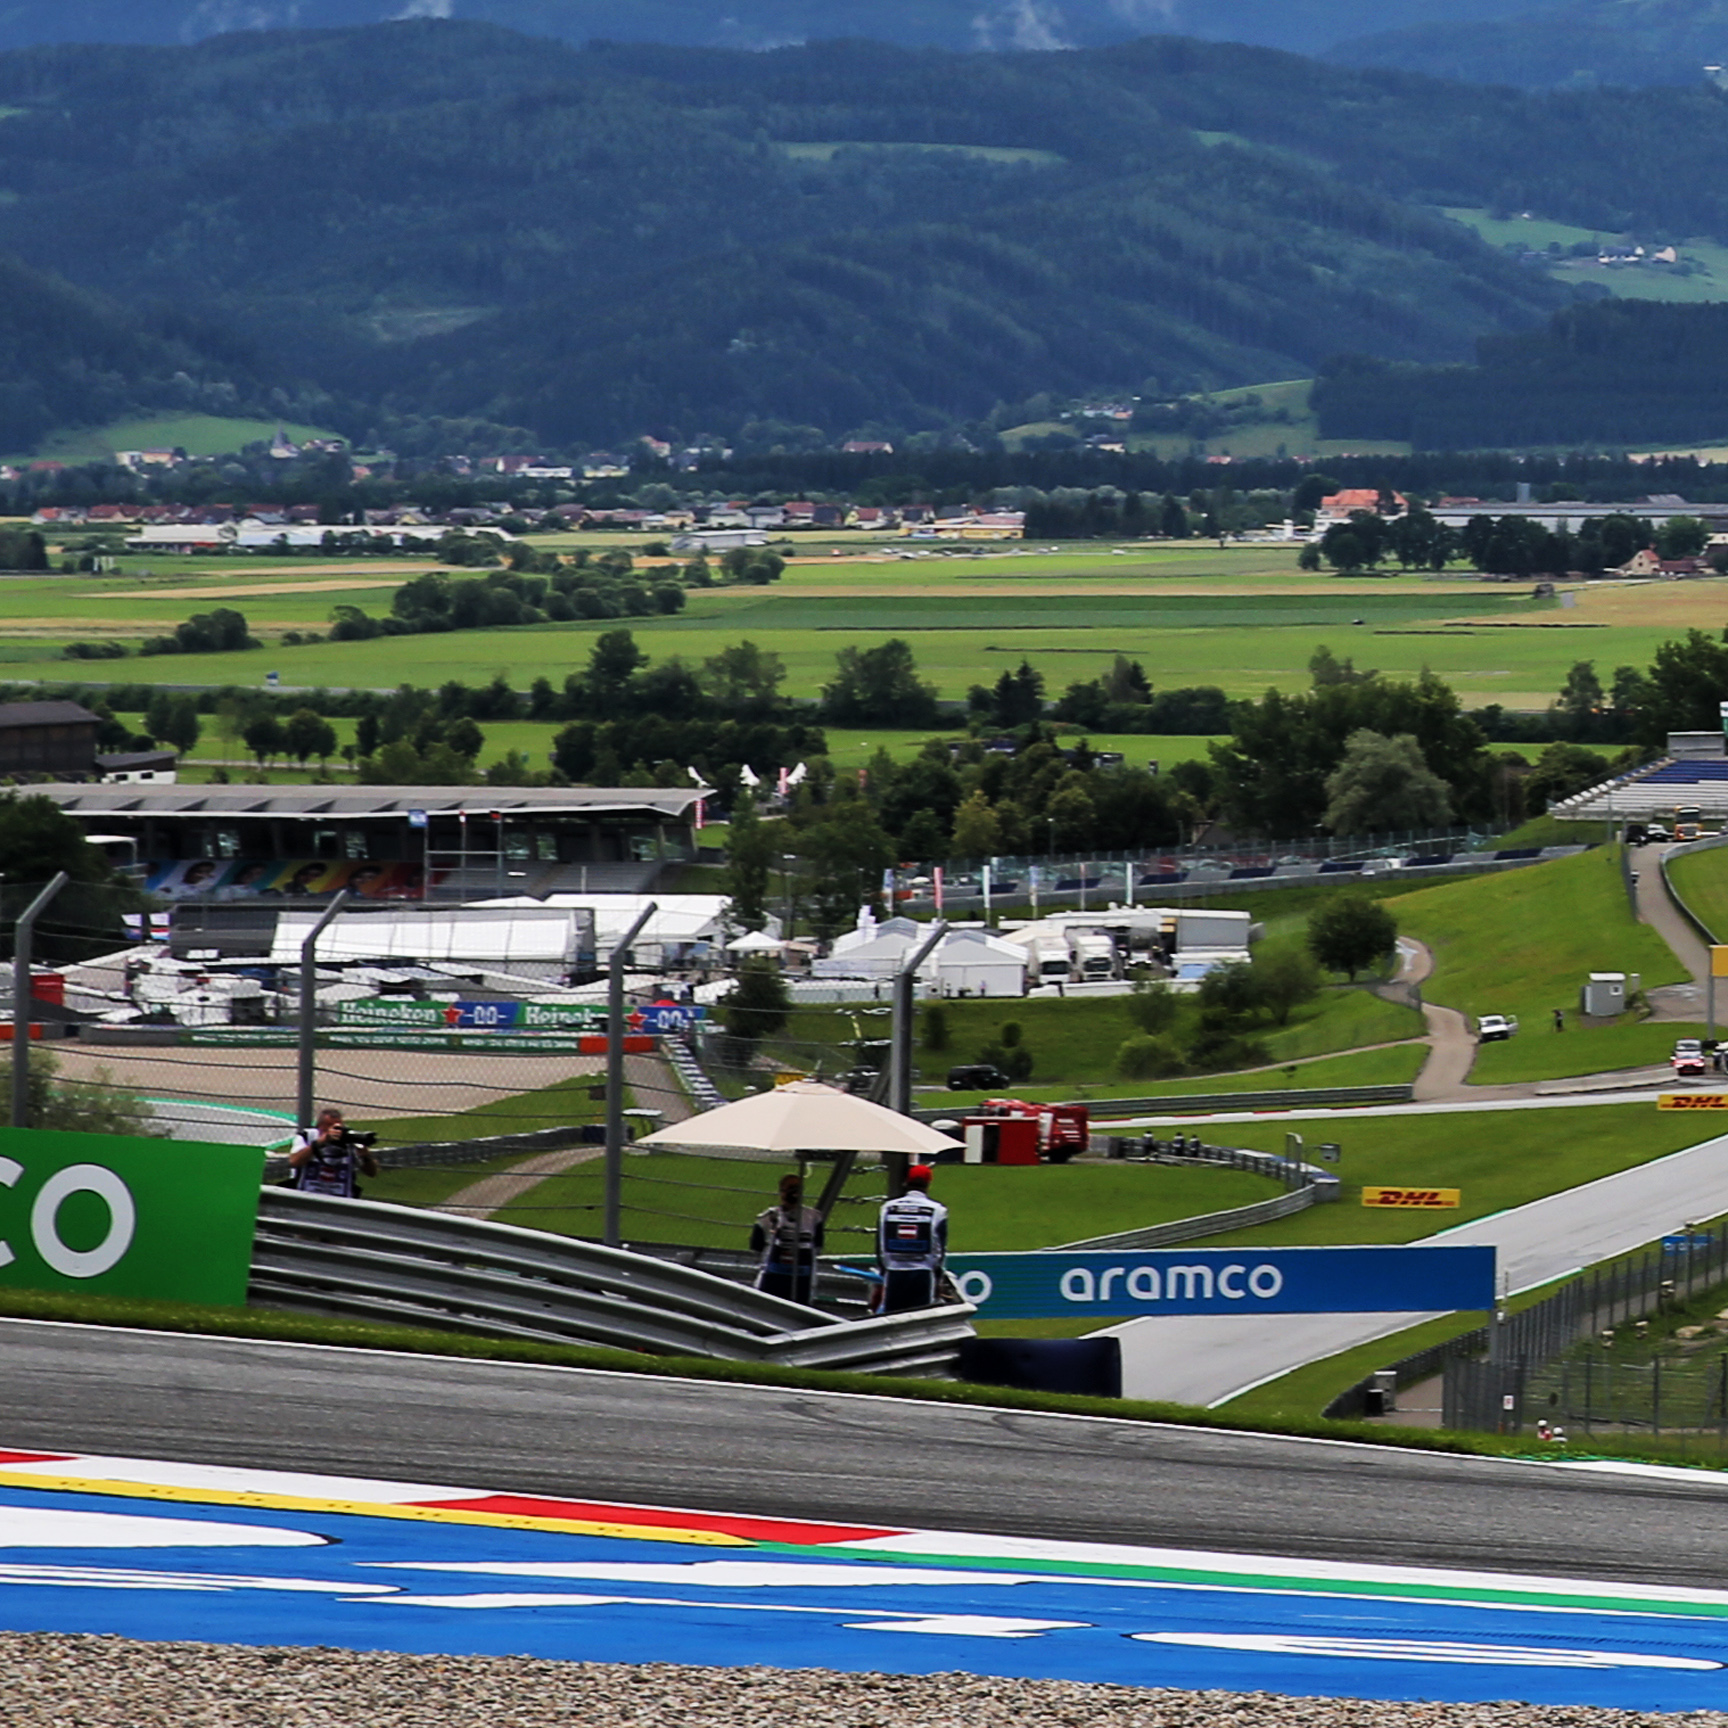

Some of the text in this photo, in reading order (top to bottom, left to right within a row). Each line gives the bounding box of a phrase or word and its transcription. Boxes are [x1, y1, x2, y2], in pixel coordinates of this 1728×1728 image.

[1672, 1096, 1727, 1108] DHL
[1378, 1191, 1442, 1205] DHL
[1060, 1264, 1283, 1302] aramco
